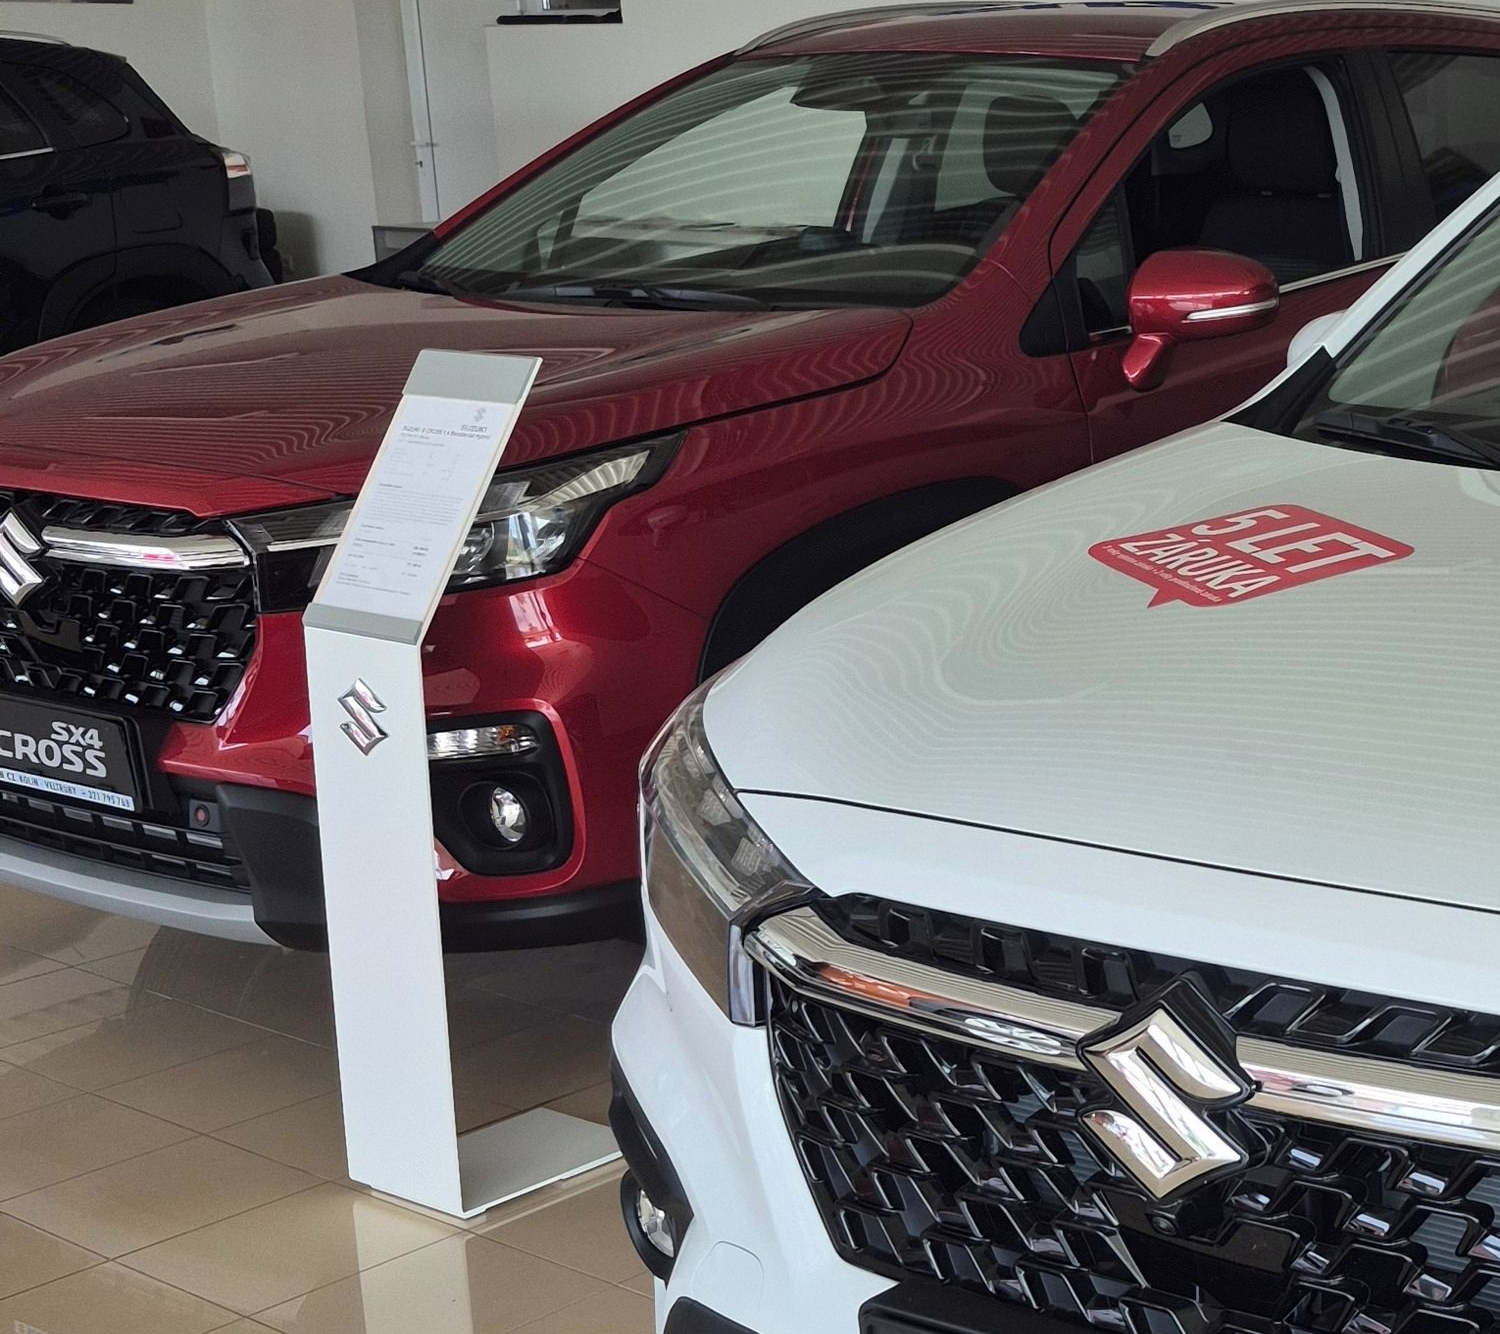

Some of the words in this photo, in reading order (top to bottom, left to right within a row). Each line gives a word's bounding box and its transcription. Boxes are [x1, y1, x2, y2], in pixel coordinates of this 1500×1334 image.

[1191, 509, 1290, 535] 5
[1119, 532, 1281, 598] ZÁRUKA
[1225, 523, 1396, 573] LET
[50, 721, 103, 749] SX4
